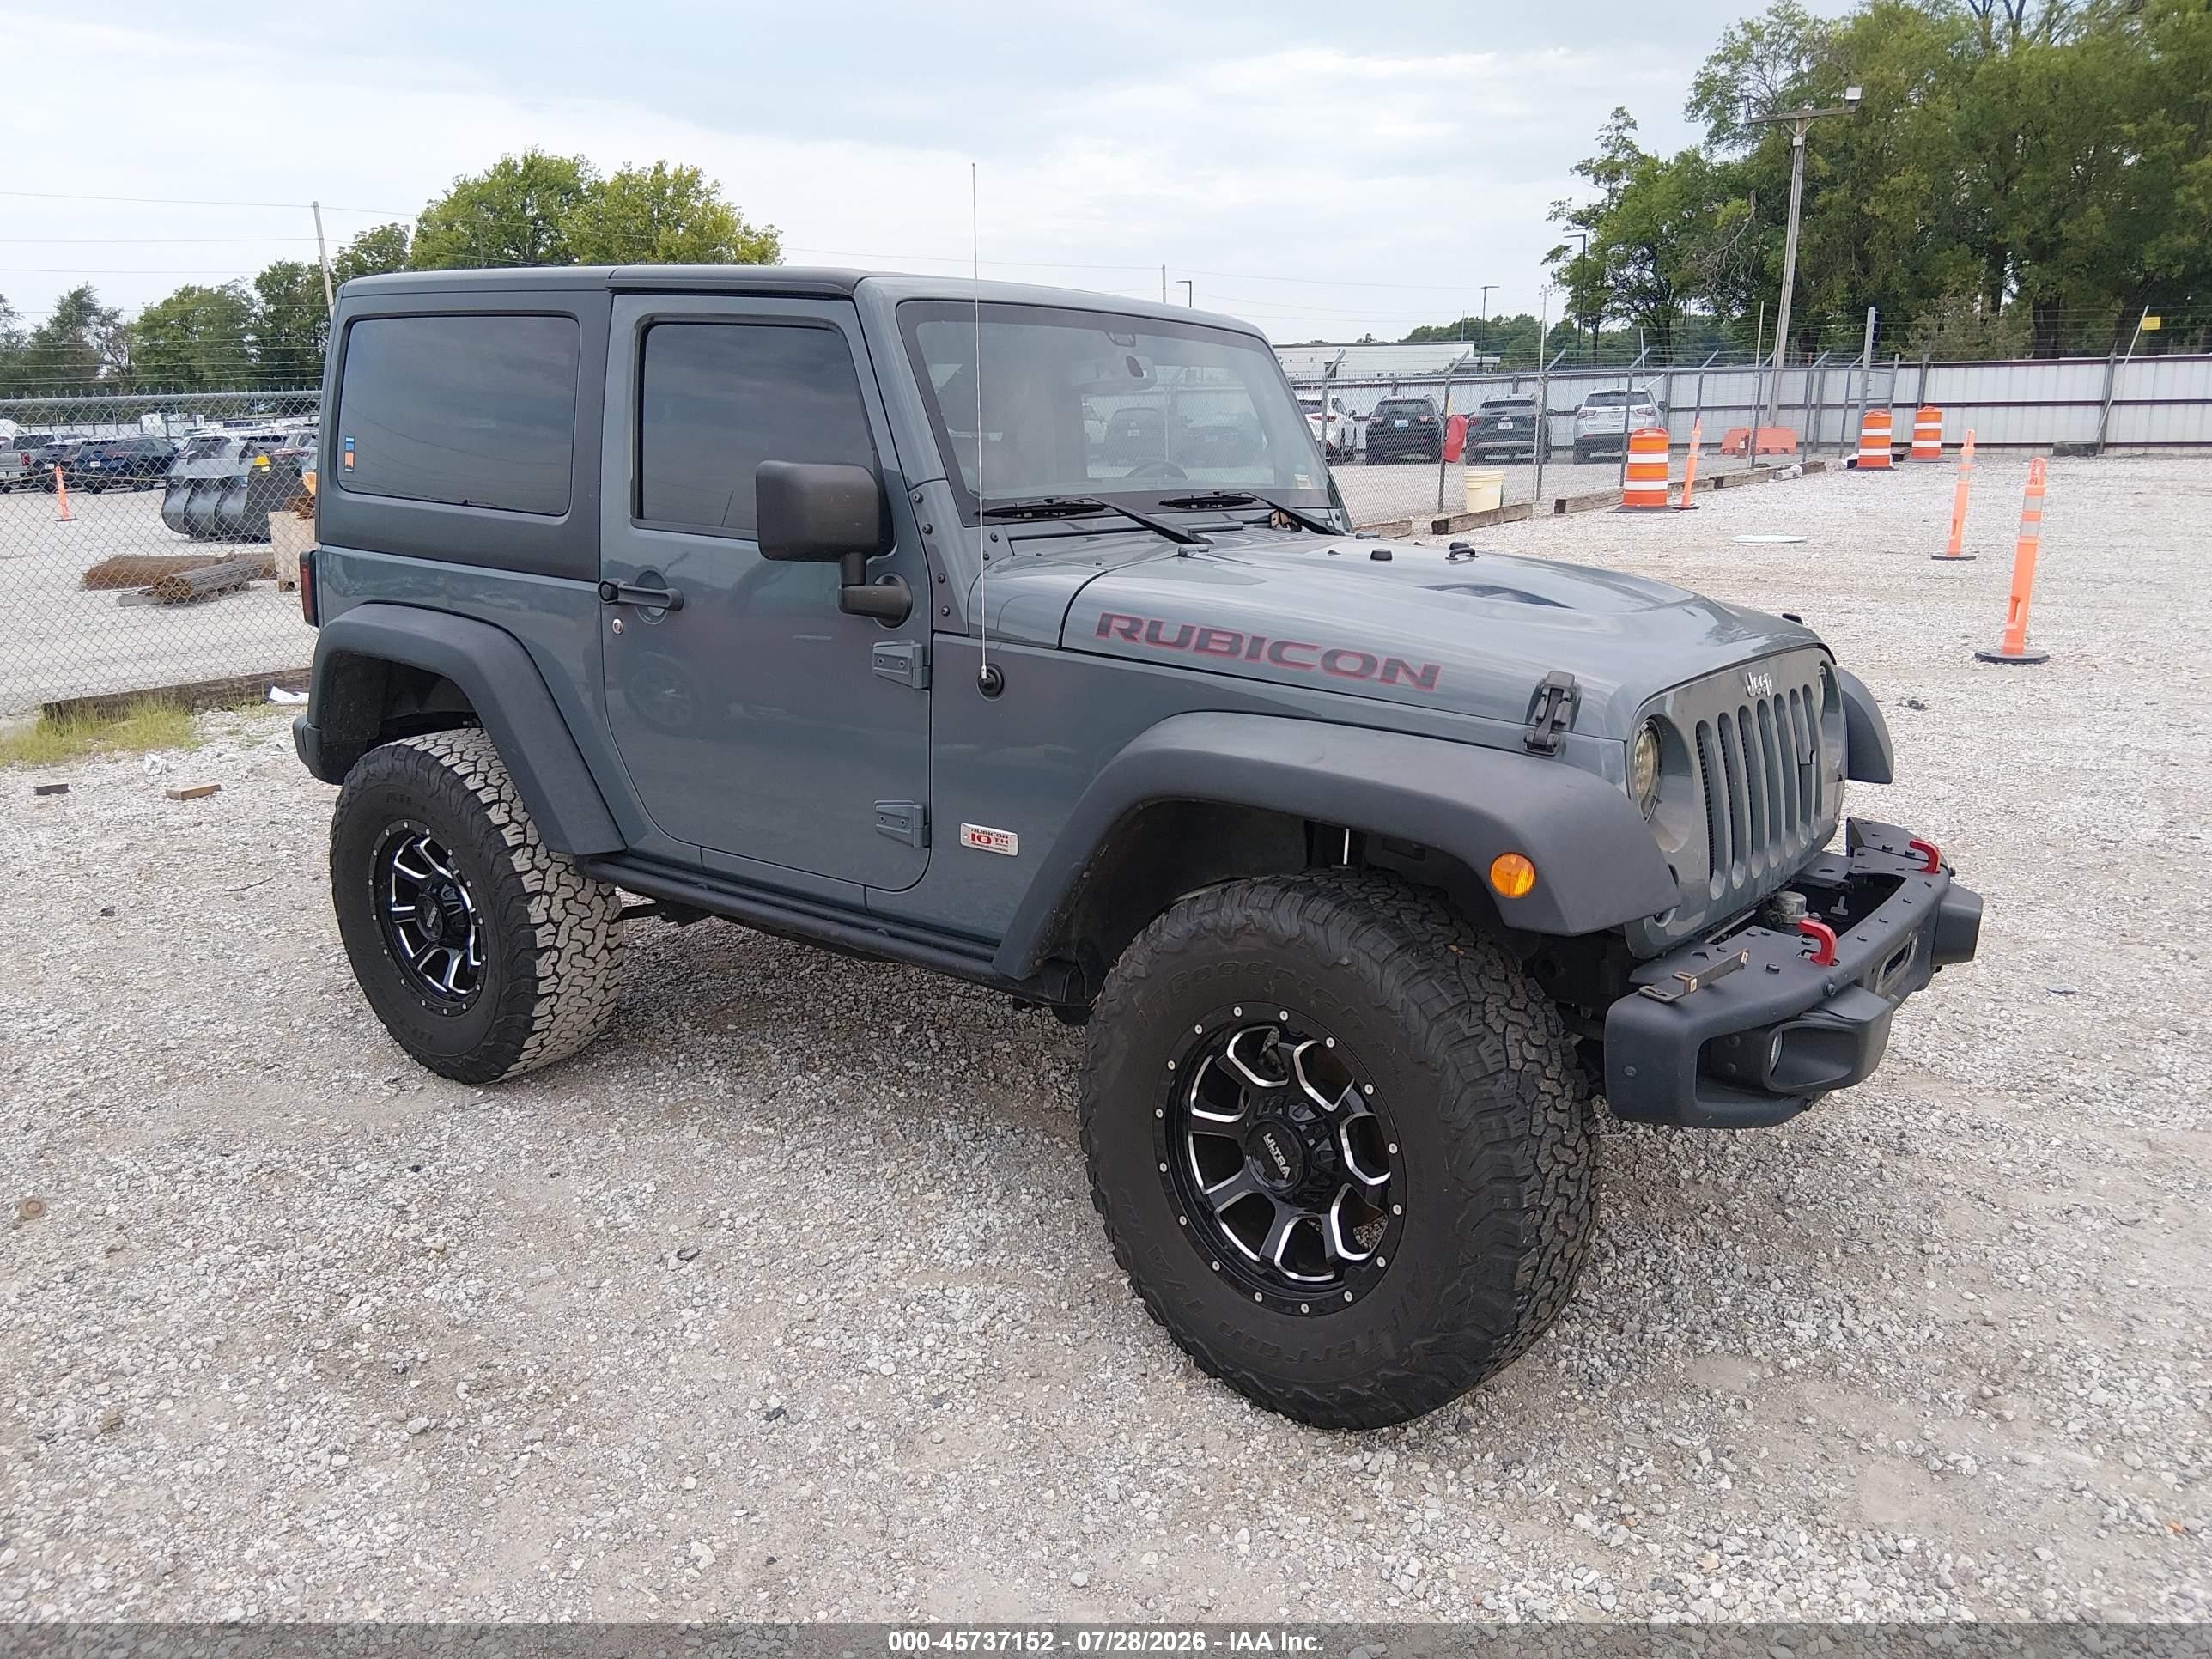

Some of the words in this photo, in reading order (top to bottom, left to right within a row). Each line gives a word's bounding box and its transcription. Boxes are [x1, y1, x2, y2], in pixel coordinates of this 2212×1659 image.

[1095, 611, 1443, 693] RUBICON
[1745, 672, 1773, 697] Jeep
[1263, 1133, 1291, 1180] ULTRA
